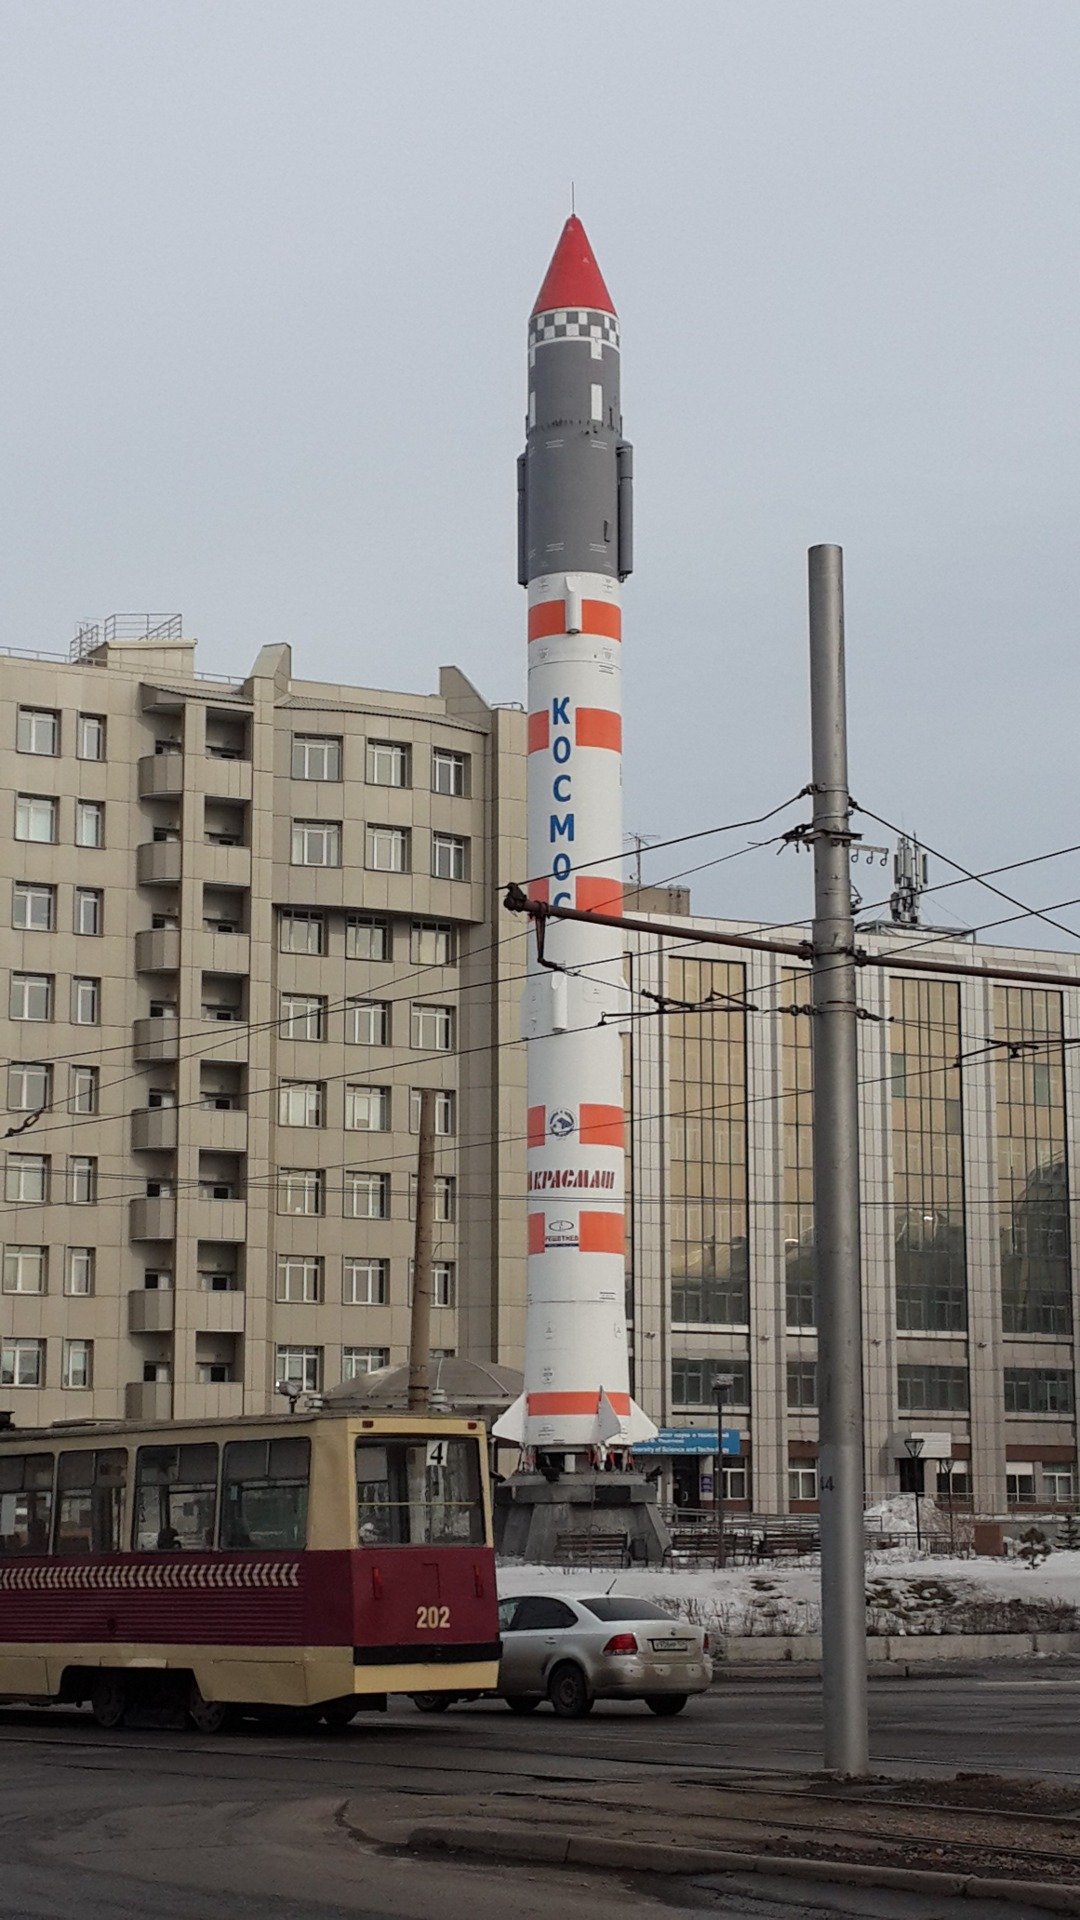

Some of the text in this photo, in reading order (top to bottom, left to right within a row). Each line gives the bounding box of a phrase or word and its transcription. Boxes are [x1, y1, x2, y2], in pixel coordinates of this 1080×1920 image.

[534, 1170, 615, 1190] КРАСМАШ
[430, 1442, 443, 1465] 4
[416, 1606, 451, 1629] 202
